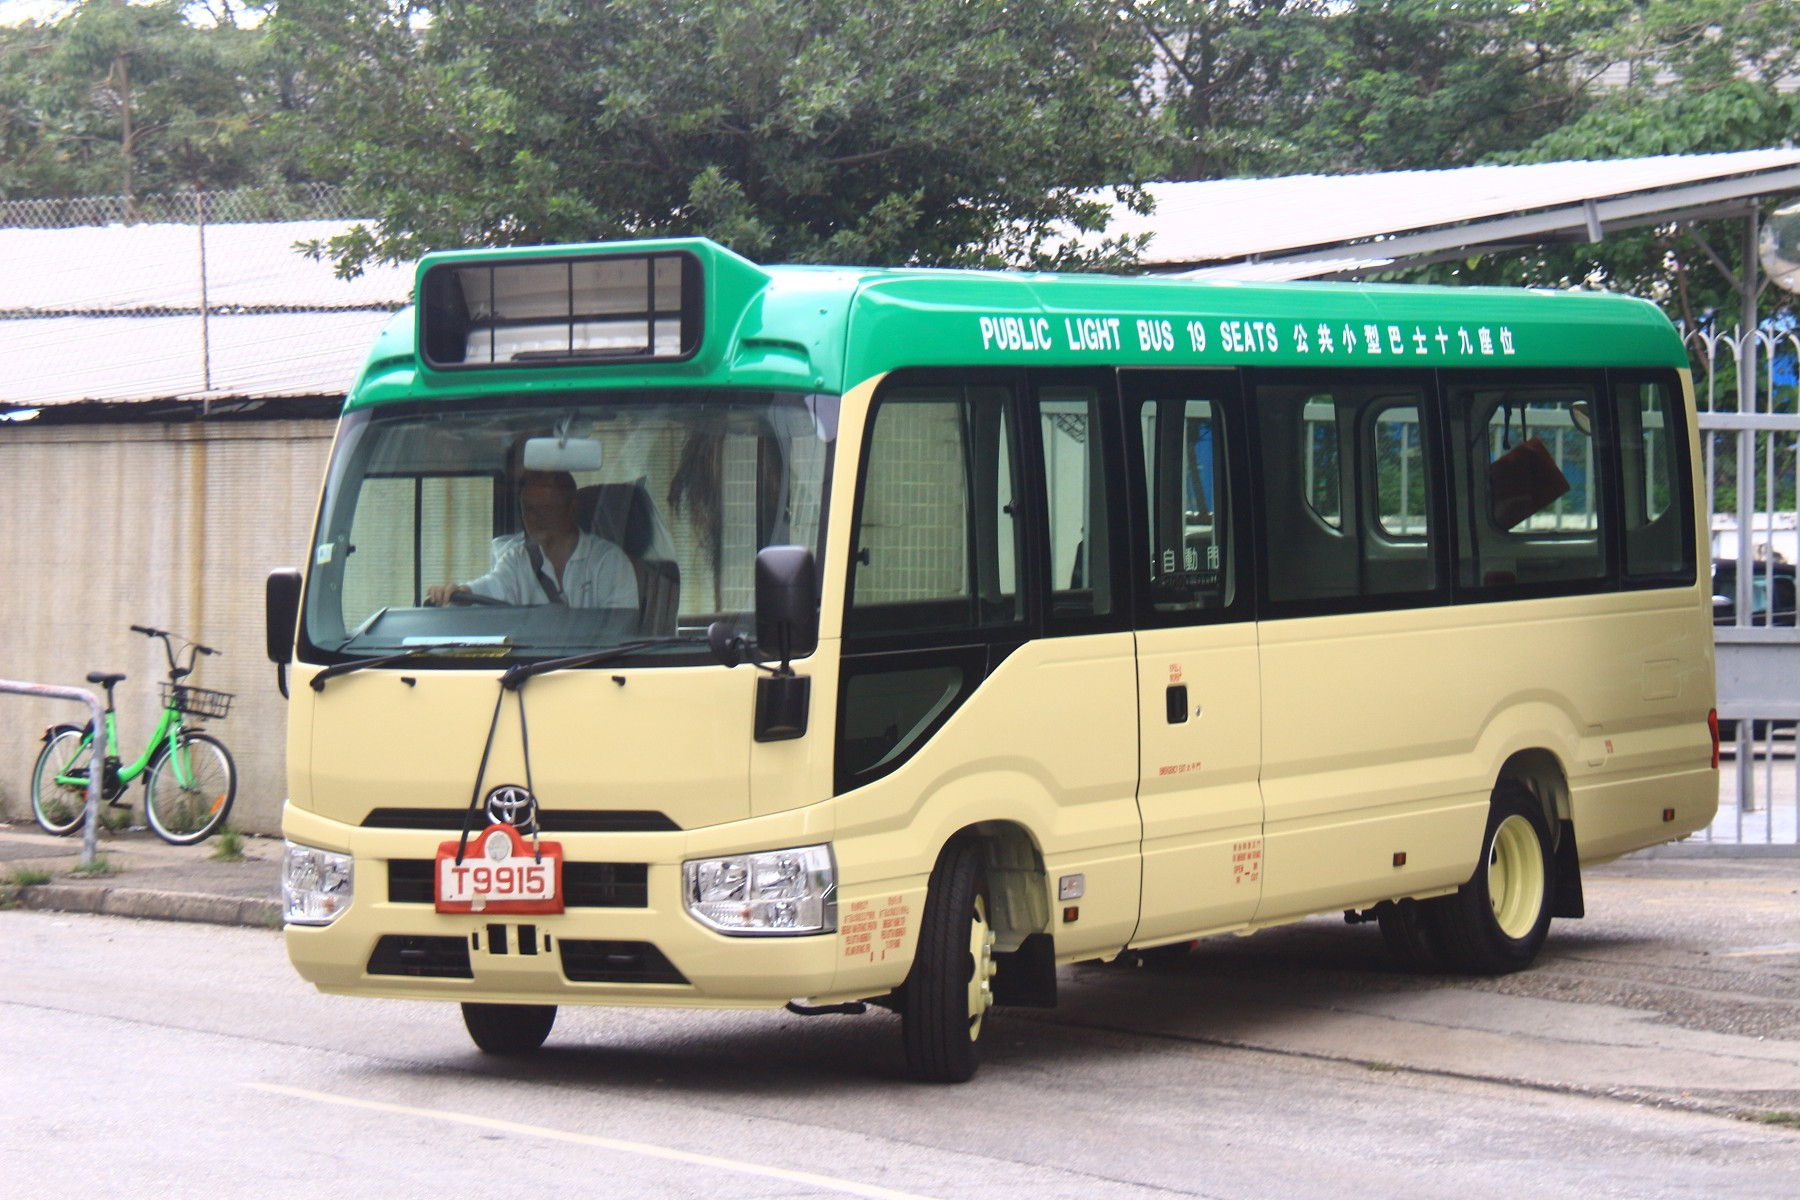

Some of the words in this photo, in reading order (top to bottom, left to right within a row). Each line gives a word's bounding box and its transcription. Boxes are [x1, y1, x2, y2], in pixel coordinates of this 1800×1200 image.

[979, 316, 1051, 350] PUBLIC
[1064, 317, 1120, 351] LIGHT
[1136, 319, 1174, 352] BUS
[1186, 321, 1206, 352] 19
[1219, 321, 1279, 353] SEATS
[1293, 323, 1515, 355] 公共小型巴士十九座位
[451, 866, 546, 895] T9915
